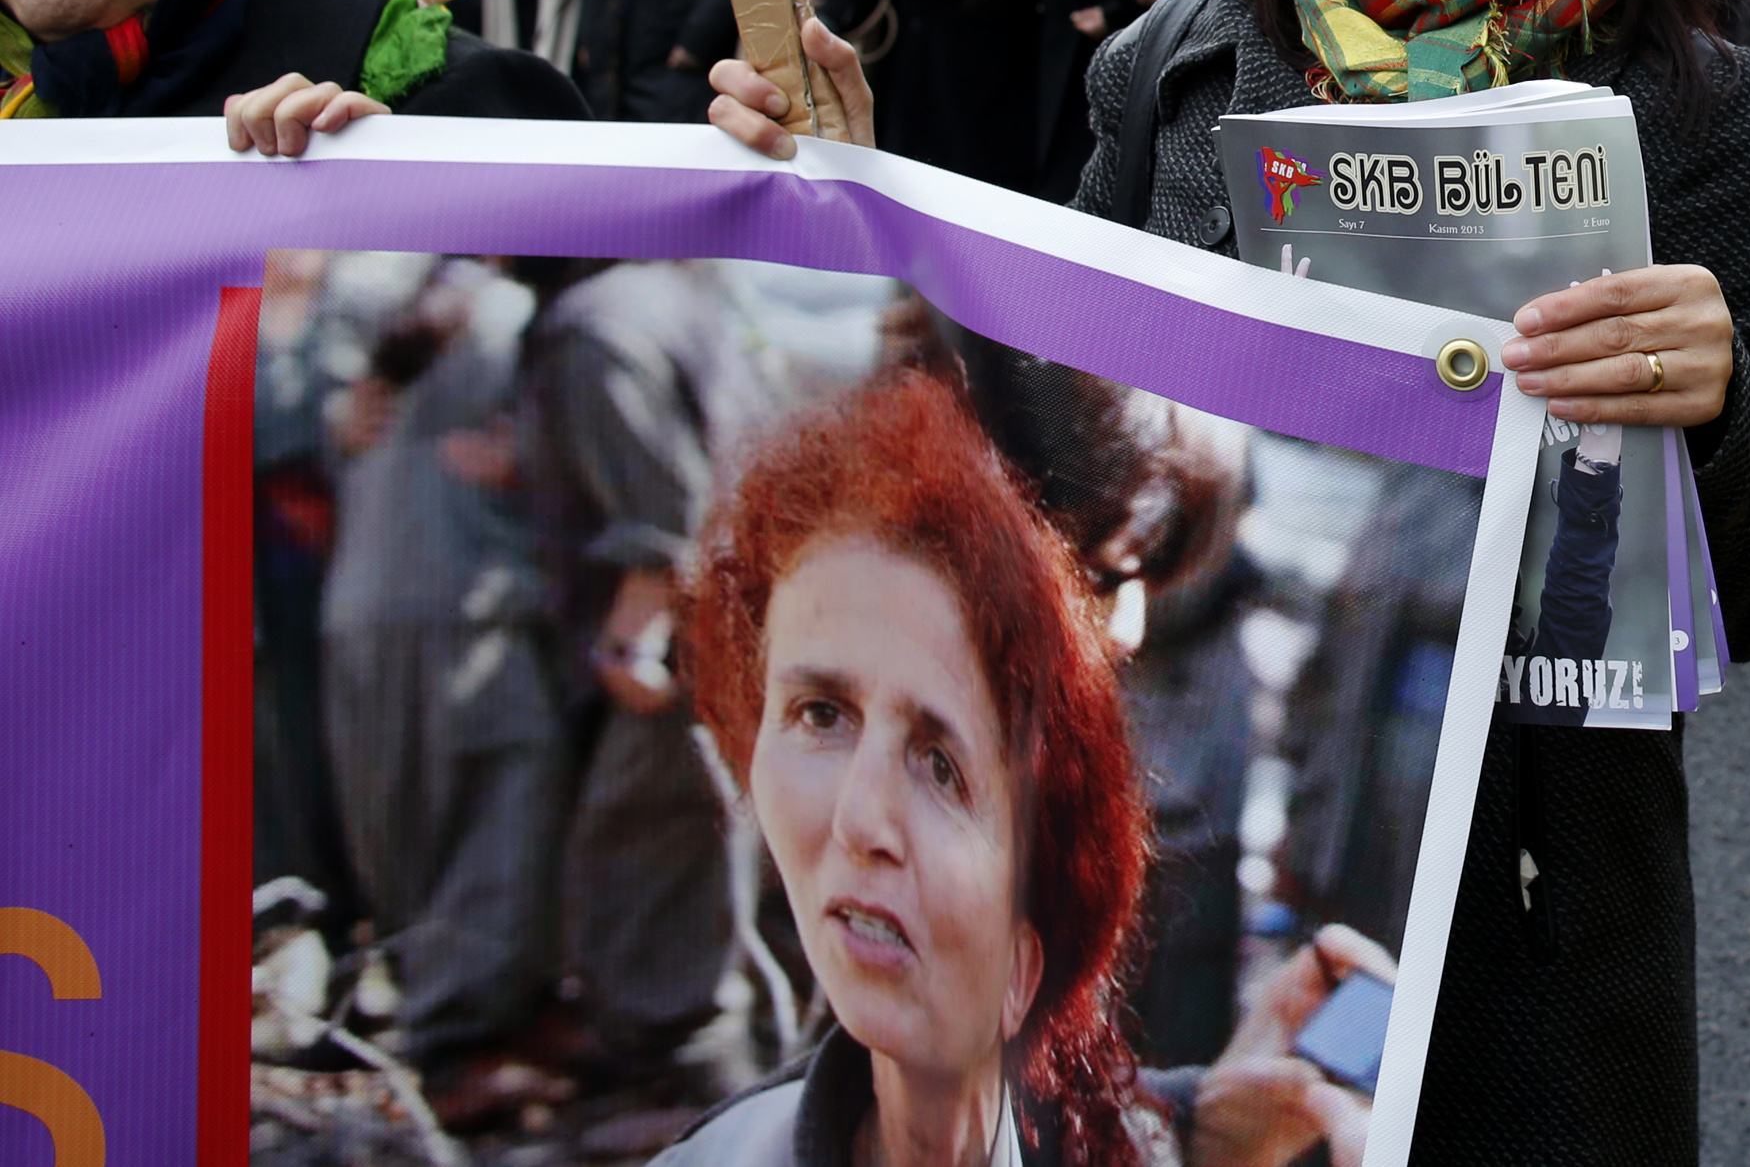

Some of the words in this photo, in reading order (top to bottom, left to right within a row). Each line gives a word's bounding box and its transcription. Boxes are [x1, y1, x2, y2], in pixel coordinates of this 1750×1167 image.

[1271, 160, 1294, 179] SKB
[1330, 152, 1423, 215] SKB
[1339, 218, 1358, 230] Sayı
[1358, 220, 1365, 229] 7
[1428, 223, 1459, 234] Kasım
[1460, 225, 1485, 234] 2013
[1583, 219, 1589, 228] 2
[1591, 217, 1610, 227] Euro
